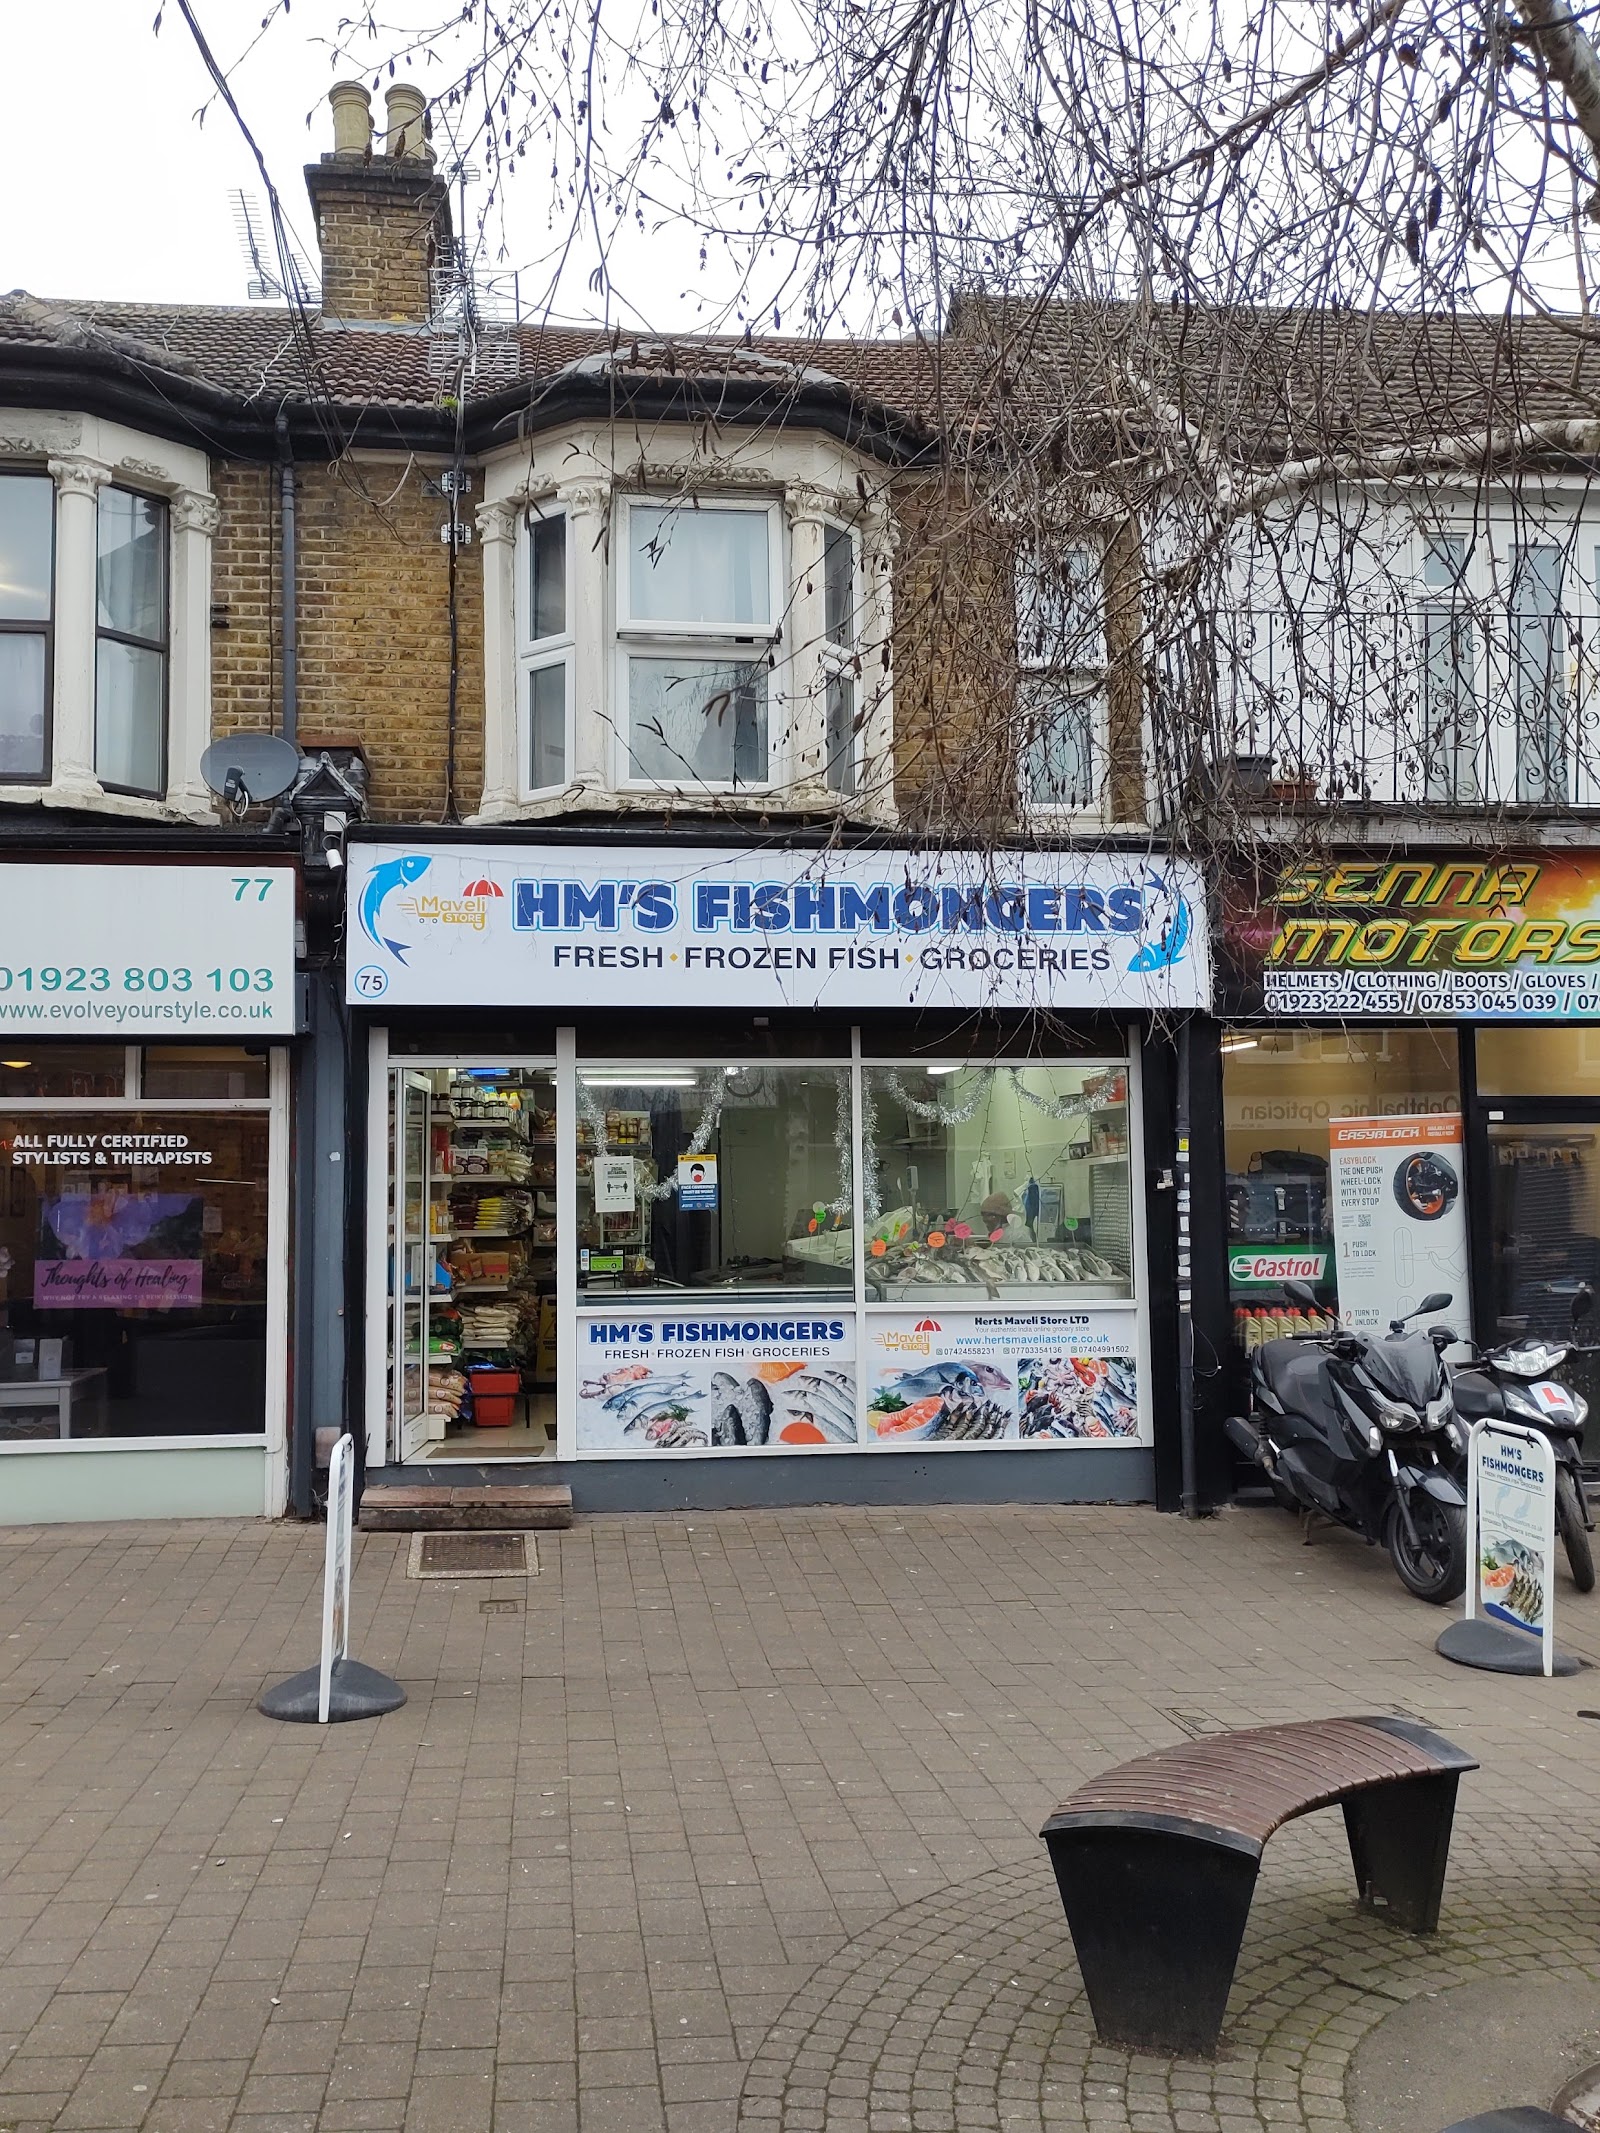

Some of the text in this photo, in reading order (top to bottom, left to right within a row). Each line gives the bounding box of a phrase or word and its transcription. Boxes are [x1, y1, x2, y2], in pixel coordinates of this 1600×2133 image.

[231, 878, 274, 901] 77
[1261, 863, 1541, 907] SENNA
[421, 896, 485, 912] Maveli
[515, 881, 1147, 932] HM'S FISHMONGERS
[445, 913, 482, 922] STORE
[1264, 918, 1600, 967] MOTORS
[553, 946, 1110, 971] FRESH FROZEN FISH GROCERIES
[0, 967, 274, 992] 01923 803 103
[359, 975, 383, 991] 75
[1266, 974, 1339, 989] HELMETS
[1357, 974, 1436, 989] CLOTHING
[1455, 974, 1508, 989] BOOTS
[1526, 975, 1586, 989] GLOVES
[1267, 993, 1323, 1011] 01923
[1326, 993, 1362, 1011] 222
[1366, 993, 1399, 1011] 455
[1421, 994, 1477, 1011] 07853
[1483, 994, 1517, 1010] 045
[1522, 994, 1557, 1010] 039
[1578, 994, 1600, 1009] 07
[1338, 1127, 1420, 1140] EASYBLOCK
[12, 1135, 42, 1148] ALL
[47, 1135, 97, 1148] FULLY
[101, 1135, 188, 1148] CERTIFIED
[12, 1152, 212, 1164] STYLISTS & THERAPISTS
[1339, 1156, 1377, 1165] EASYBLOCK
[1340, 1165, 1383, 1176] THE ONE PUSH
[1340, 1177, 1382, 1186] WHEEL-LOCK
[1341, 1187, 1380, 1196] WITH YOU AT
[1341, 1197, 1380, 1207] EVERY STOP
[1343, 1242, 1350, 1257] 1
[1253, 1257, 1320, 1278] Castrol
[41, 1262, 191, 1295] Thoughts of Healing
[975, 1316, 1089, 1325] Herts Maveli Store LTD
[1345, 1310, 1352, 1326] 2
[1355, 1318, 1378, 1326] UNLOCK
[589, 1321, 845, 1343] HM'S FISHMONGERS
[887, 1332, 930, 1342] Maveli
[605, 1347, 830, 1359] FRESH FROZEN FISH GROCERIES
[1542, 1387, 1567, 1404] L
[1501, 1445, 1522, 1460] HM'S
[1482, 1456, 1544, 1483] FISHMONGERS
